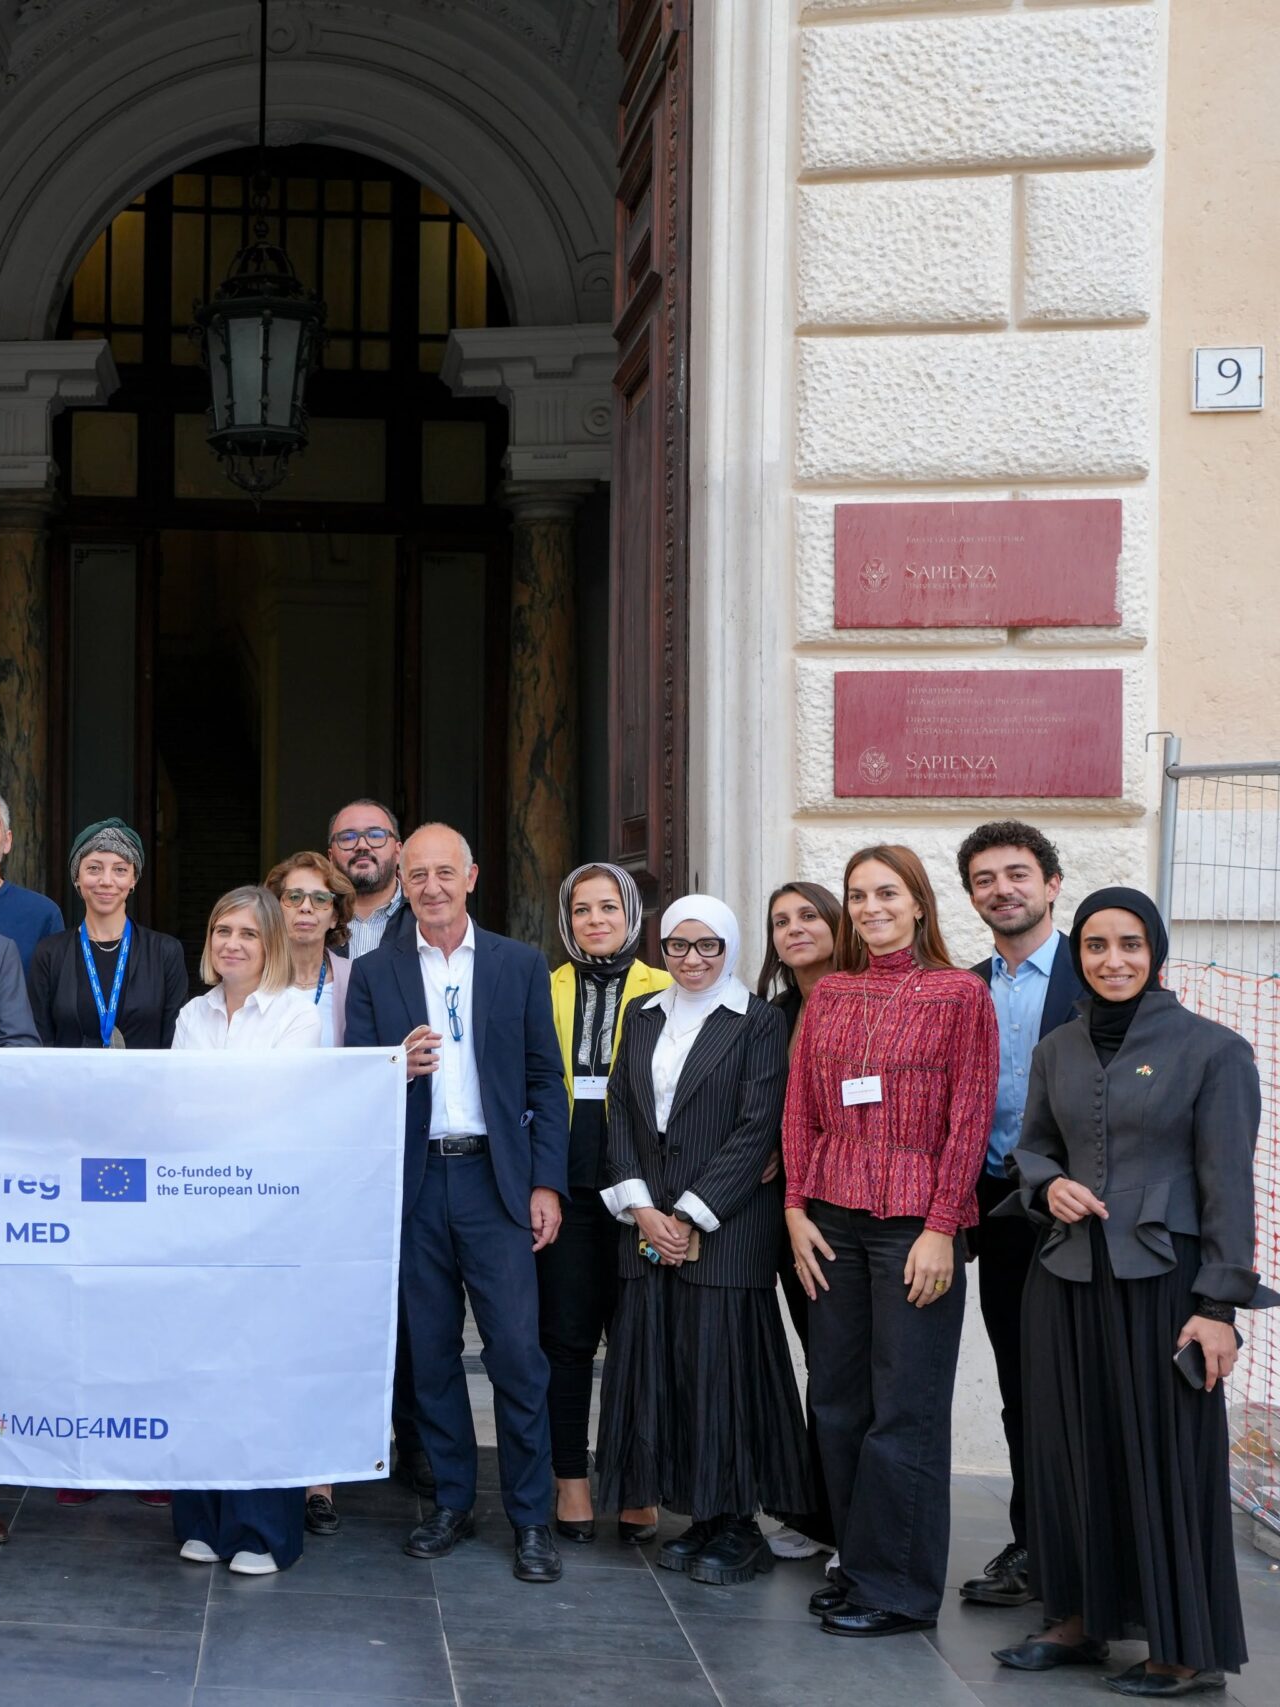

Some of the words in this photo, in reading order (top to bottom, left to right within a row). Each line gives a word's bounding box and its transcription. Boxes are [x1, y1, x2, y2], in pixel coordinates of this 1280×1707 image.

[1216, 358, 1242, 396] 9
[906, 562, 996, 579] SAPIENZA
[906, 752, 997, 770] SAPIENZA
[156, 1166, 231, 1178] Co-funded
[236, 1166, 253, 1180] by
[156, 1184, 179, 1195] the
[184, 1184, 252, 1198] European
[258, 1183, 300, 1195] Union
[6, 1222, 70, 1243] MED
